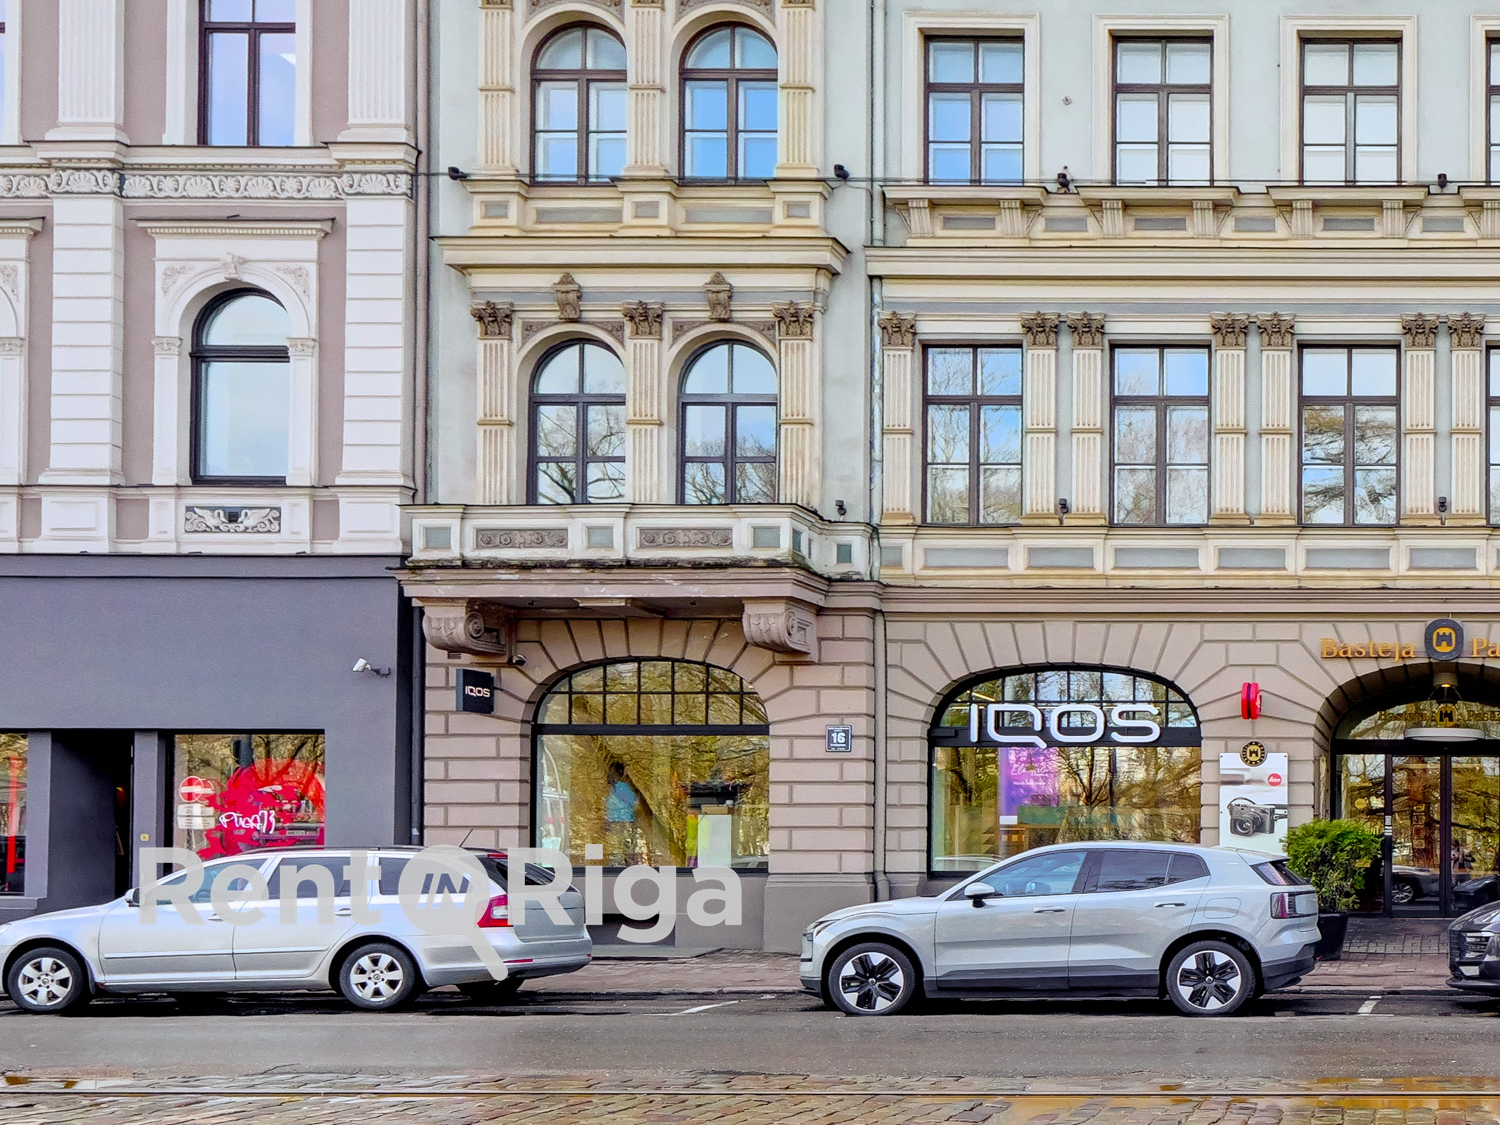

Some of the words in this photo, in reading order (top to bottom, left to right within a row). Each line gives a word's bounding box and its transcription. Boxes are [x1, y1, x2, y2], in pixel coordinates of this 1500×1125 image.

[1320, 637, 1416, 663] Basteja
[465, 685, 491, 698] IQOS
[969, 703, 1161, 749] IQOS
[831, 732, 846, 744] 16
